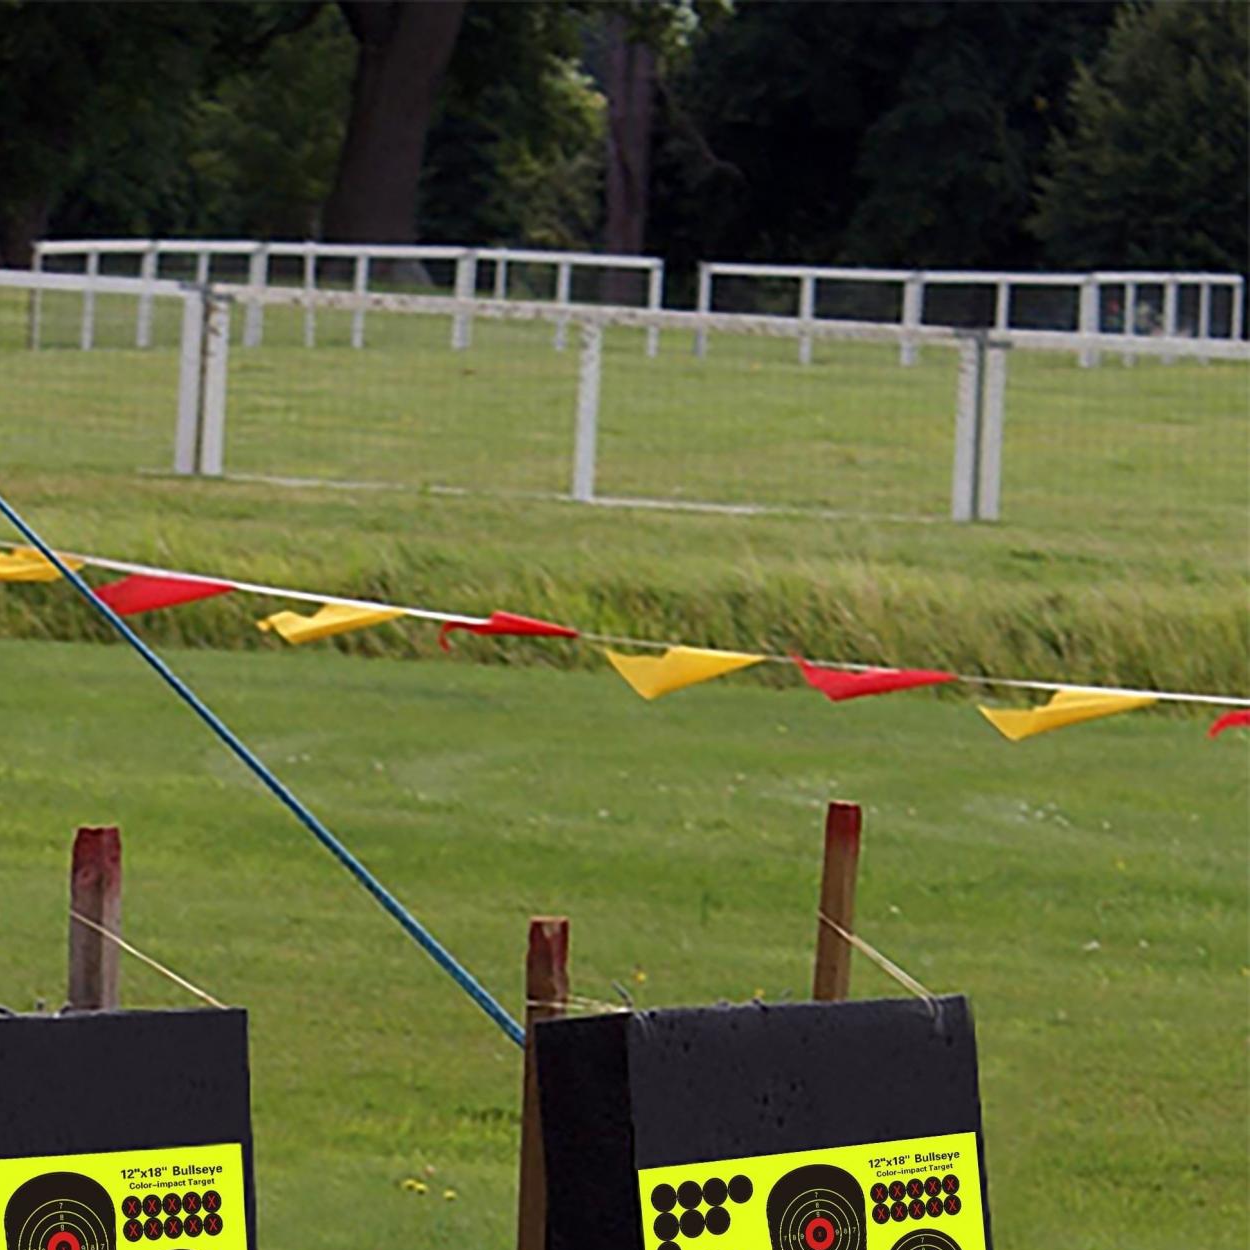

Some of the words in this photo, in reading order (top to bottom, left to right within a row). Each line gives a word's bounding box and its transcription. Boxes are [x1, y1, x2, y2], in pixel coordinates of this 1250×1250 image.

[915, 1152, 960, 1163] Bullseye
[173, 1165, 223, 1176] Bullseye
[929, 1163, 953, 1171] Target
[188, 1178, 215, 1186] Target
[876, 1187, 883, 1199] X
[893, 1185, 901, 1197] X
[911, 1183, 919, 1195] X
[929, 1181, 937, 1192] X
[946, 1179, 955, 1191] X
[127, 1201, 136, 1214] X
[147, 1199, 156, 1212] X
[168, 1198, 176, 1211] X
[188, 1197, 196, 1209] X
[208, 1195, 216, 1208] X
[877, 1208, 885, 1220] X
[895, 1206, 903, 1217] X
[913, 1203, 921, 1215] X
[931, 1201, 939, 1213] X
[949, 1200, 957, 1210] X
[129, 1224, 138, 1237] X
[149, 1223, 158, 1236] X
[170, 1221, 178, 1234] X
[189, 1220, 198, 1232] X
[209, 1218, 218, 1231] X
